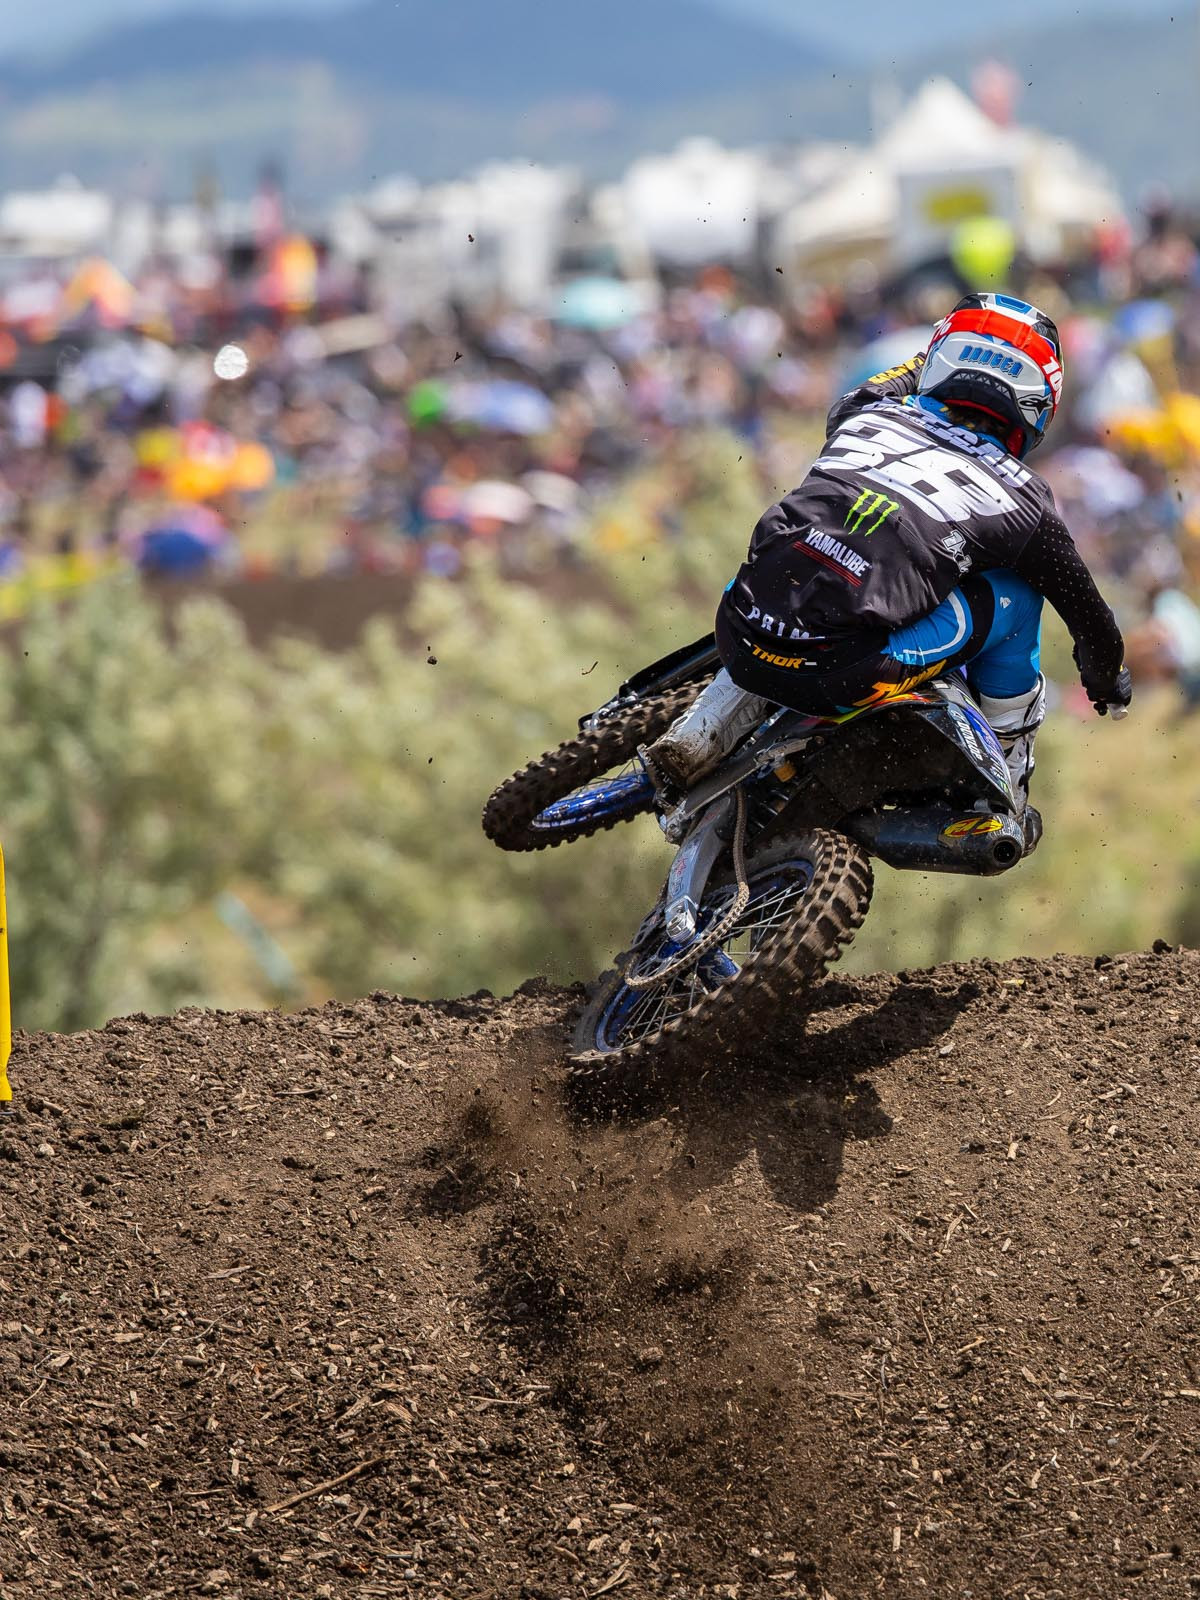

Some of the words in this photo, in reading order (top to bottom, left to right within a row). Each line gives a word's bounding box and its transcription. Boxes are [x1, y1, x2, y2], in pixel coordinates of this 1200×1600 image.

[804, 527, 871, 577] YAMALUBE
[747, 605, 826, 639] PRIM
[752, 643, 803, 669] THOR
[956, 720, 983, 761] DUNLOP
